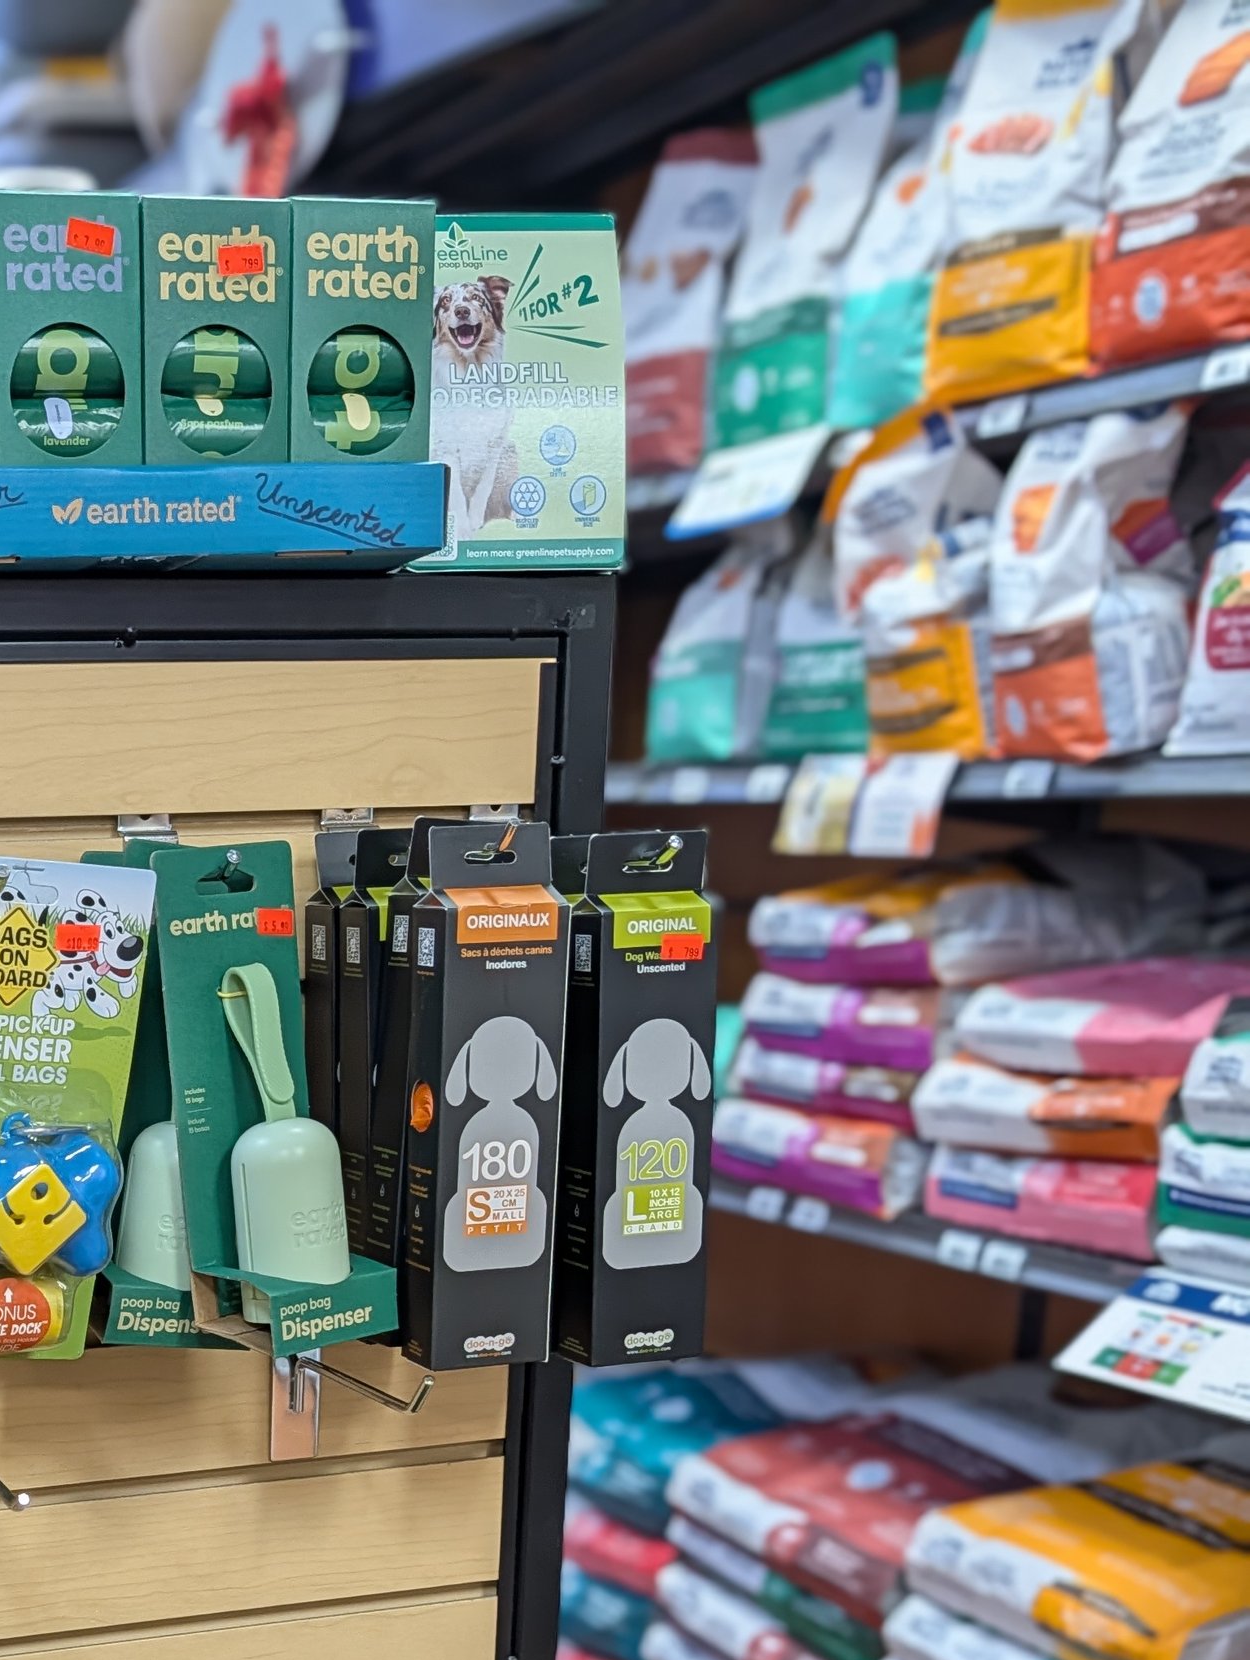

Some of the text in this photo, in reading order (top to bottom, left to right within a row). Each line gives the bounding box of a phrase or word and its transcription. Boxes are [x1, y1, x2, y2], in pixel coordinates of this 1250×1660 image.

[307, 225, 418, 263] earth
[308, 263, 418, 299] rated
[529, 292, 563, 320] FOR
[450, 362, 568, 384] LANDFILL
[87, 497, 236, 525] earth rated
[255, 472, 406, 547] Unscented
[467, 549, 488, 557] learn
[516, 548, 614, 559] greenlinepetsupply.com
[170, 910, 228, 936] earth
[467, 913, 550, 929] ORIGINAUX
[627, 918, 697, 934] ORIGINAL
[0, 948, 29, 967] ON
[461, 946, 553, 958] Sacs à déchets canins
[625, 952, 644, 963] Dog
[486, 959, 527, 970] Inodores
[637, 962, 686, 974] Unscented
[11, 1063, 68, 1085] BAGS
[462, 1139, 533, 1182] 180
[619, 1137, 688, 1181] 120
[649, 1197, 681, 1208] INCHES
[466, 1224, 524, 1235] PETIT
[624, 1221, 681, 1233] GRAND
[280, 1297, 331, 1319] poop bag
[281, 1303, 373, 1343] Dispenser
